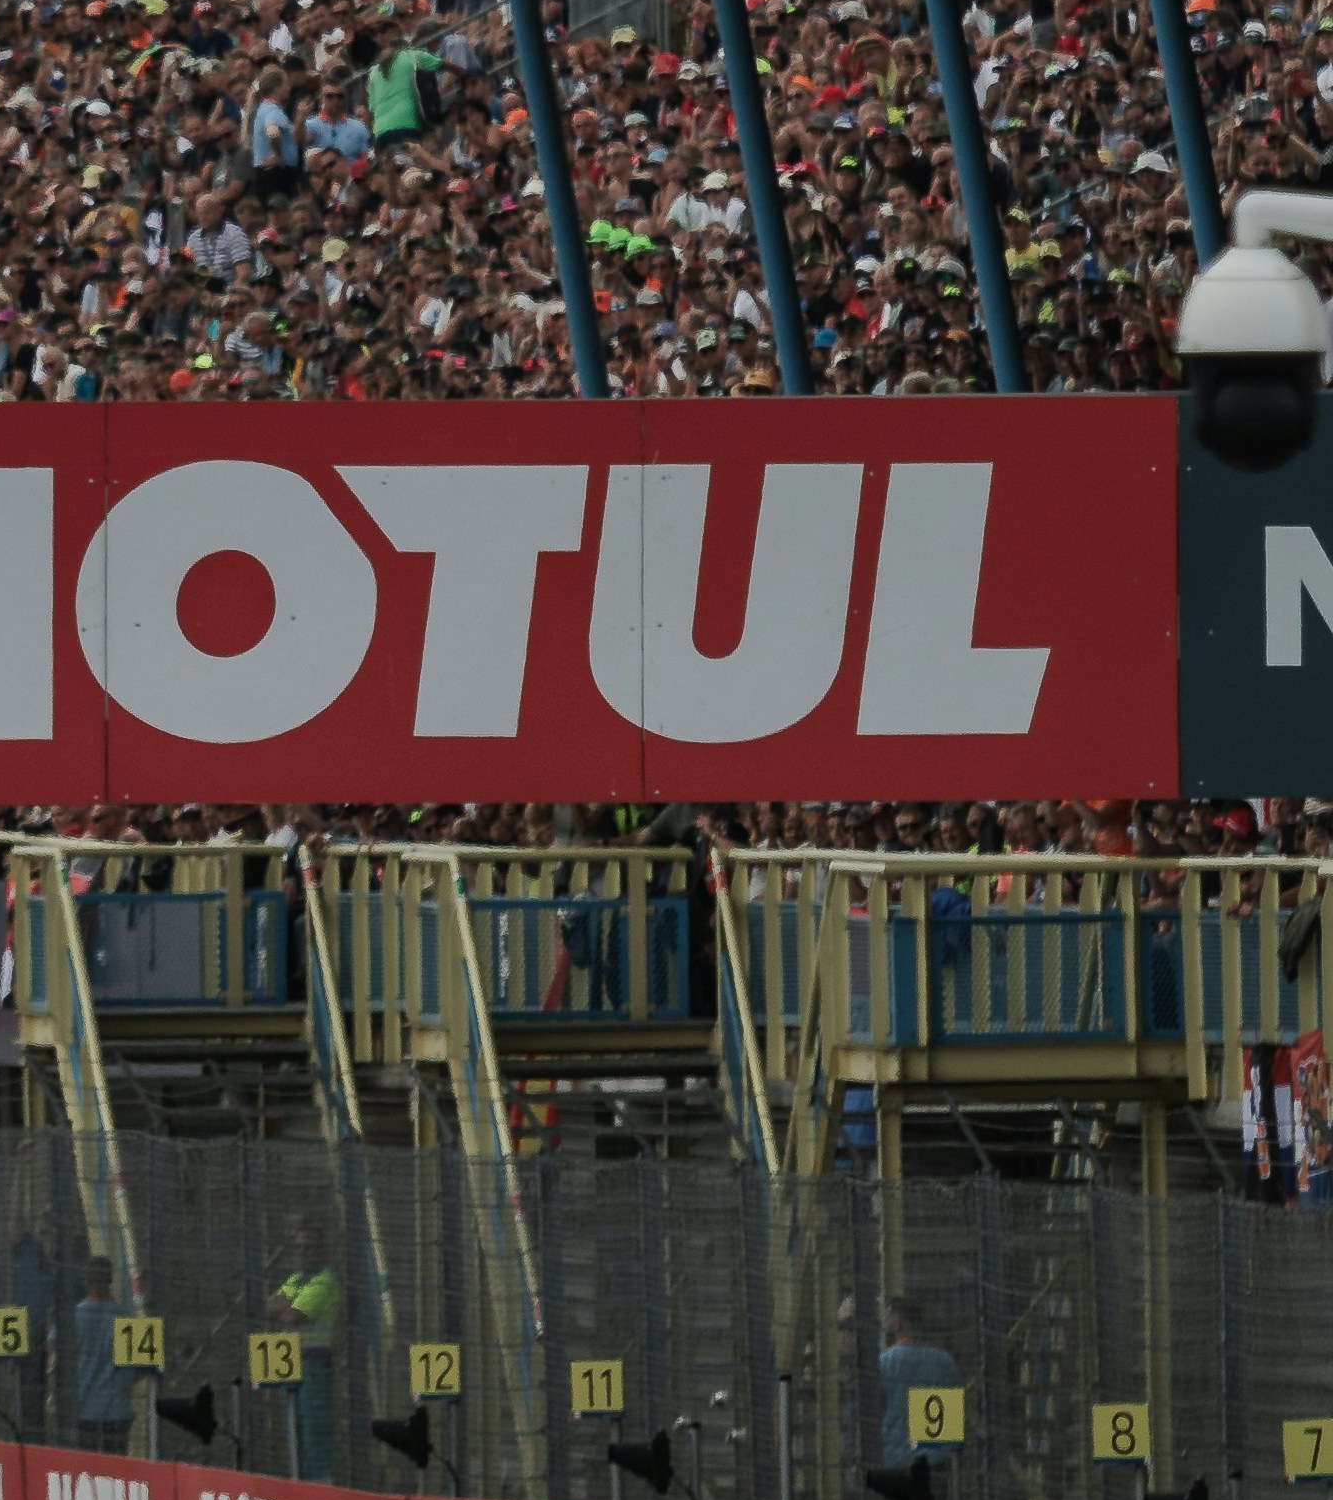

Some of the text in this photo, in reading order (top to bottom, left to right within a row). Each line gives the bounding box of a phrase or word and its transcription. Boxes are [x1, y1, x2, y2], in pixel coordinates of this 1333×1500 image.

[121, 1324, 158, 1360] 14
[256, 1338, 295, 1378] 13
[419, 1351, 455, 1391] 12
[581, 1368, 616, 1408] 11
[923, 1394, 945, 1438] 9
[1111, 1411, 1134, 1455] 8
[1303, 1427, 1324, 1471] 7
